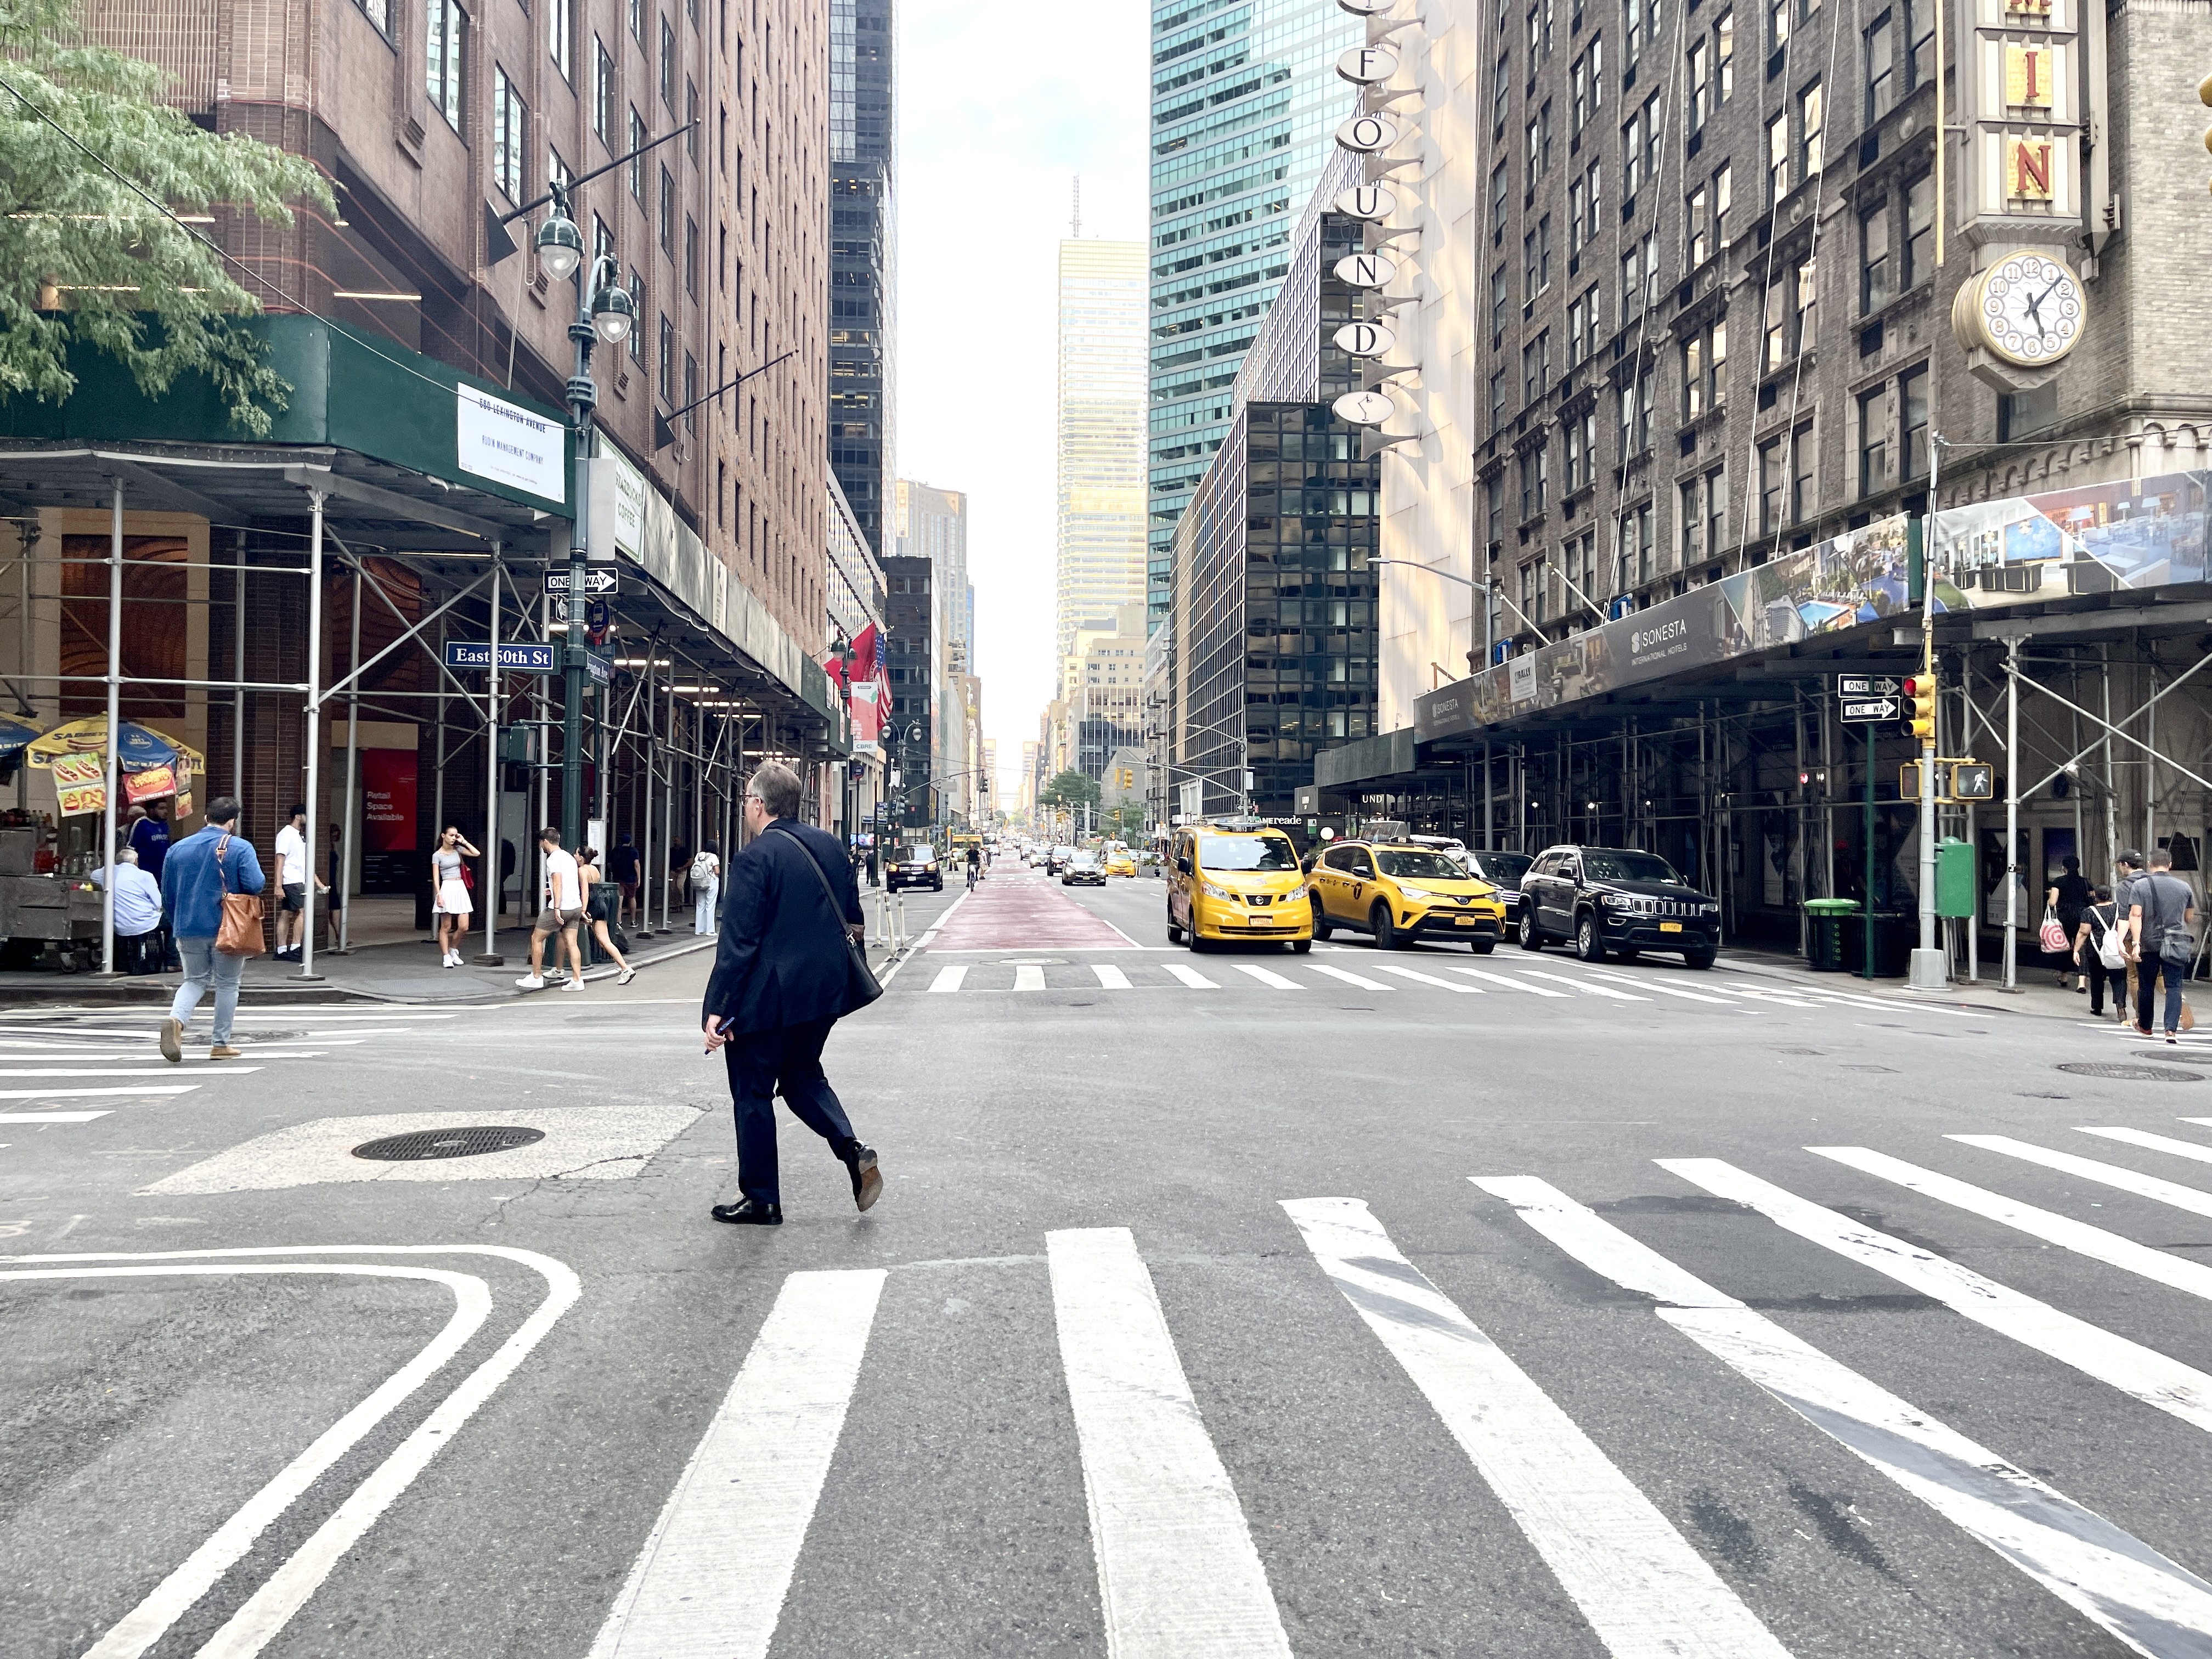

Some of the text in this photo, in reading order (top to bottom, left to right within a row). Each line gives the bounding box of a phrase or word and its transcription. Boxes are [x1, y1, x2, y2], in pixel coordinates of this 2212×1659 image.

[1353, 49, 1382, 352] FOUND
[2008, 267, 2019, 279] 11
[2026, 262, 2039, 274] 12
[2048, 268, 2054, 280] 1
[1993, 280, 2006, 293] 10
[2061, 283, 2070, 296] 2
[1990, 300, 1999, 313] 9
[2066, 303, 2074, 315] 3
[1995, 320, 2004, 332] 8
[2061, 323, 2069, 335] 4
[2008, 335, 2018, 347] 7
[2028, 341, 2037, 353] 6
[2046, 336, 2055, 348] 5
[493, 404, 523, 424] LEXINGTON
[526, 417, 545, 433] AVENUE
[496, 440, 524, 458] MANAGEMENT
[618, 501, 635, 528] COFFEE
[551, 576, 607, 586] ONE WAY
[1643, 618, 1686, 647] SONESTA
[1668, 642, 1687, 656] HOTELS
[456, 648, 490, 663] East
[532, 651, 549, 665] St
[1849, 682, 1893, 691] ONE WAY
[1850, 704, 1891, 714] ONE WAY
[1362, 794, 1383, 803] UND
[366, 802, 393, 810] Space
